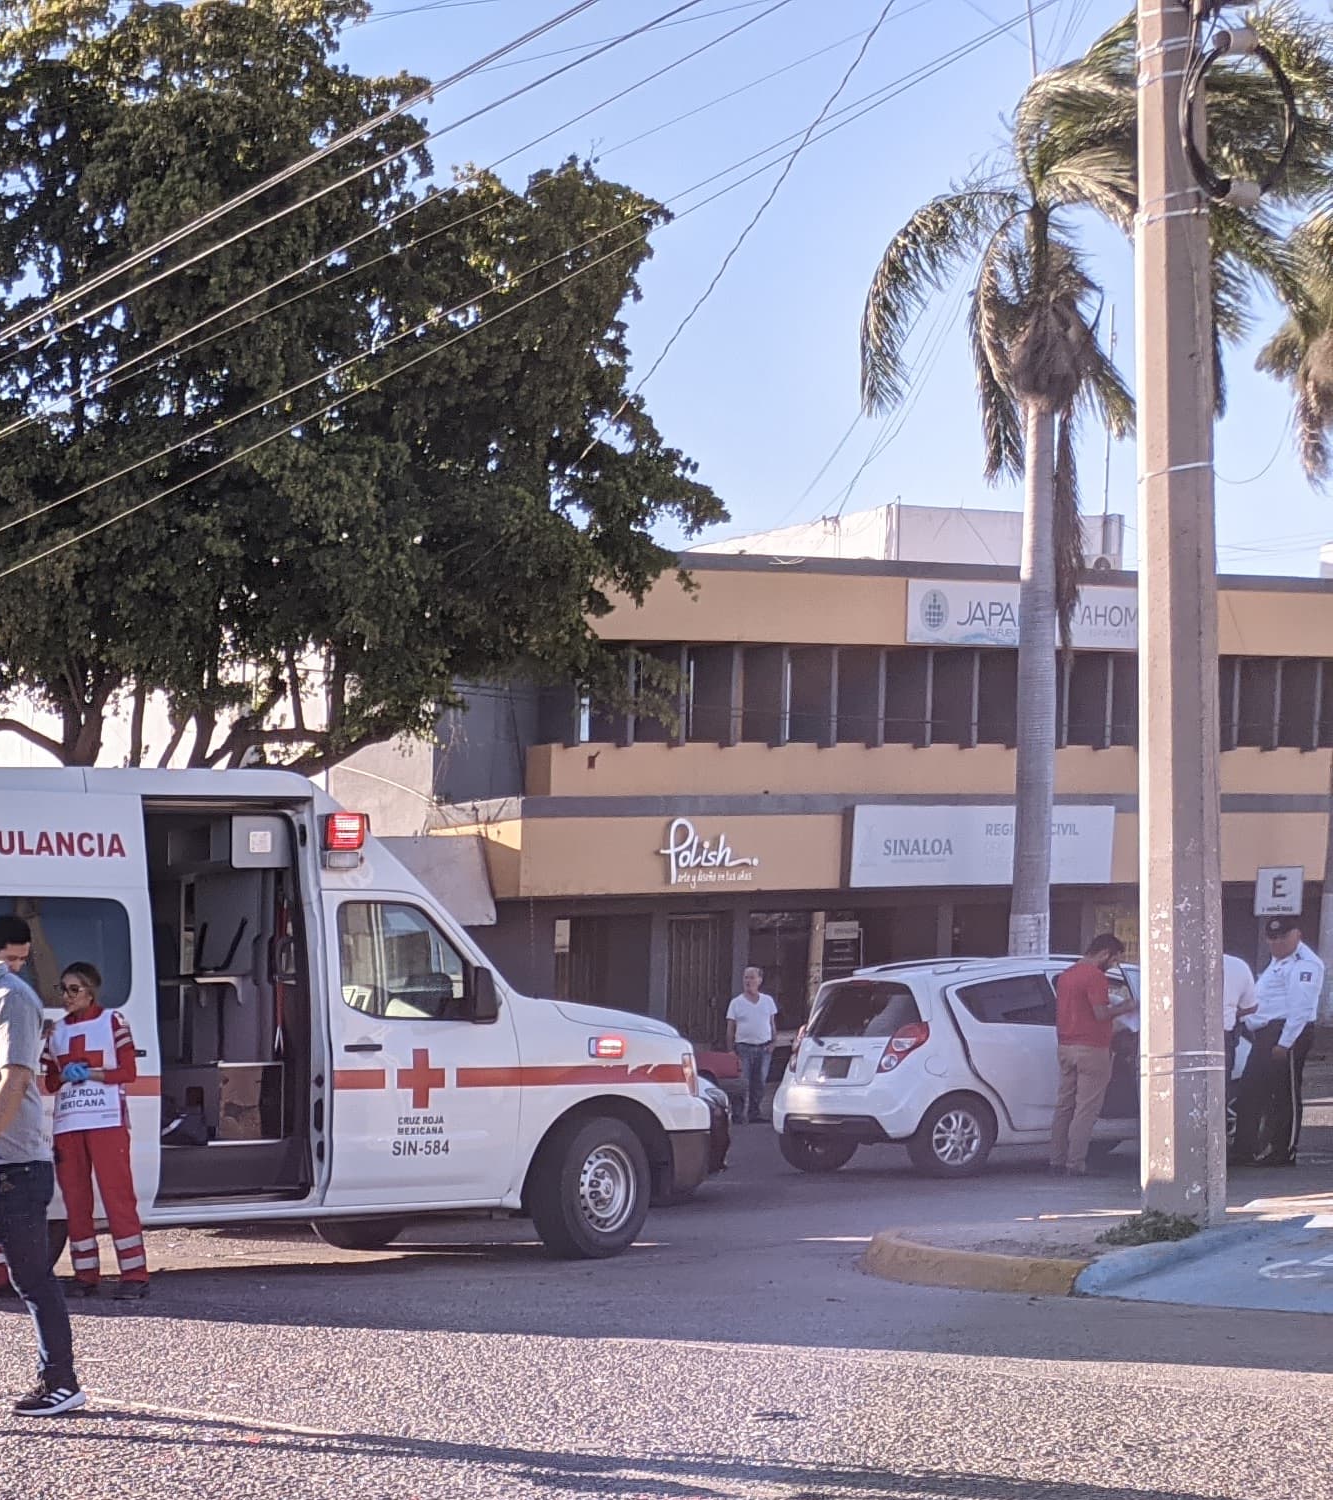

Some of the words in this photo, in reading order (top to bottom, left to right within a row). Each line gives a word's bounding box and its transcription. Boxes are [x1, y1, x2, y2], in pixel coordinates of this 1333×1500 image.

[956, 600, 1017, 627] JAPA
[1080, 605, 1138, 628] AHOM
[985, 823, 1014, 837] REGI
[882, 838, 954, 857] SINALOA
[1272, 876, 1287, 898] E
[78, 1088, 106, 1097] ROJA
[397, 1116, 421, 1126] CRUZ
[422, 1115, 445, 1125] ROJA
[396, 1125, 445, 1136] MEXICANA
[391, 1139, 450, 1157] SIN-584
